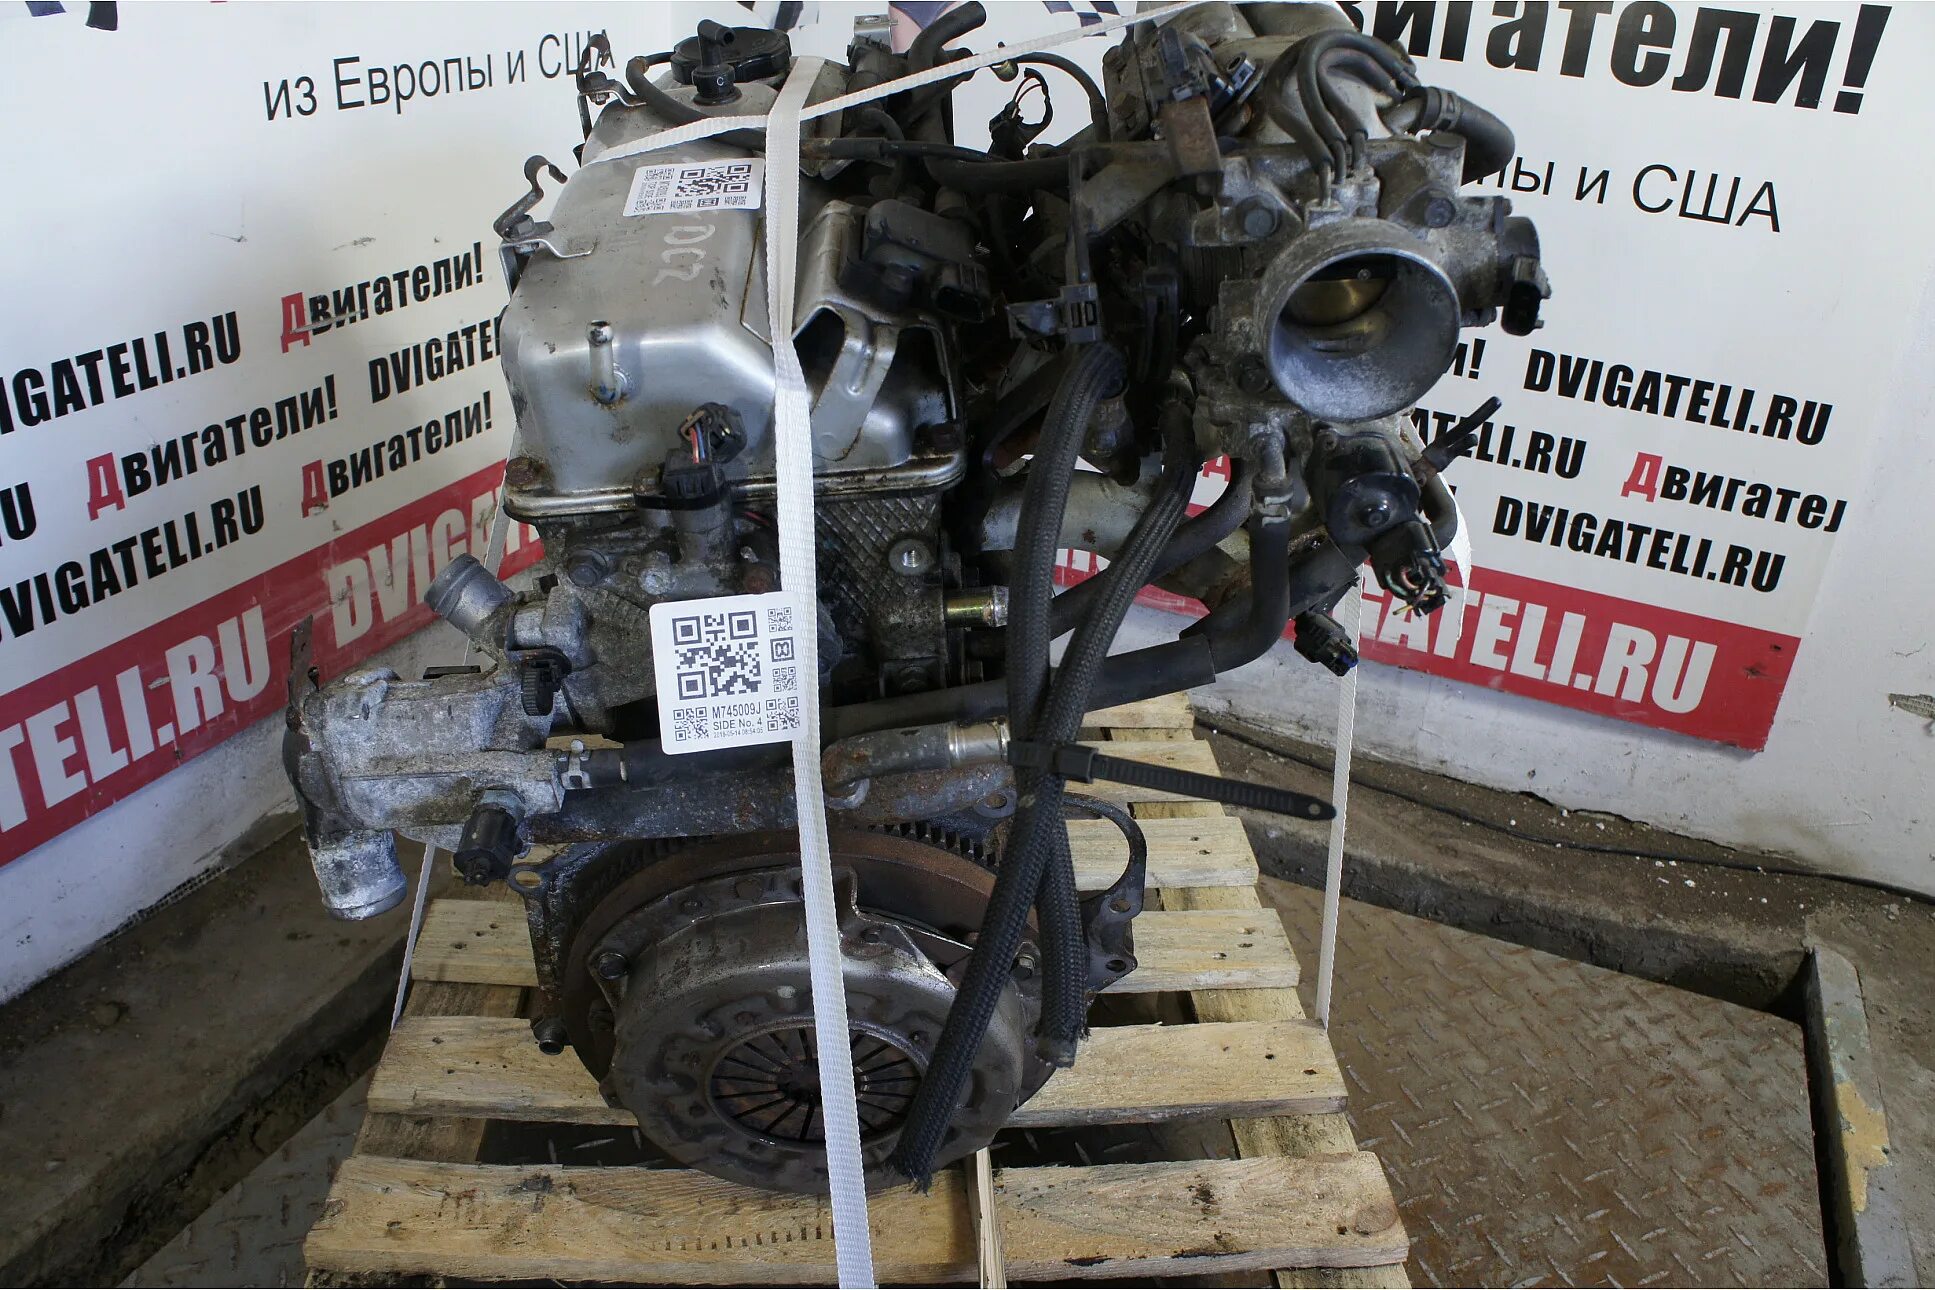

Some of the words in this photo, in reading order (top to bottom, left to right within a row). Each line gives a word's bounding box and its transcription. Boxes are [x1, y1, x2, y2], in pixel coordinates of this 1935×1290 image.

[263, 76, 317, 121] из
[333, 56, 493, 115] Европы
[507, 50, 525, 84] и
[1575, 166, 1610, 205] и
[1632, 164, 1780, 233] США
[280, 241, 483, 354] Двигатели!
[1523, 348, 1834, 446] DVIGATELI.RU
[87, 374, 337, 522] Двигатели!
[302, 390, 493, 519] Двигатели!
[0, 485, 265, 642] VIGATELI.RU
[1493, 496, 1787, 593] DVIGATELI.RU
[712, 701, 761, 719] M745009J
[713, 719, 736, 731] SIDE
[738, 718, 754, 728] No.
